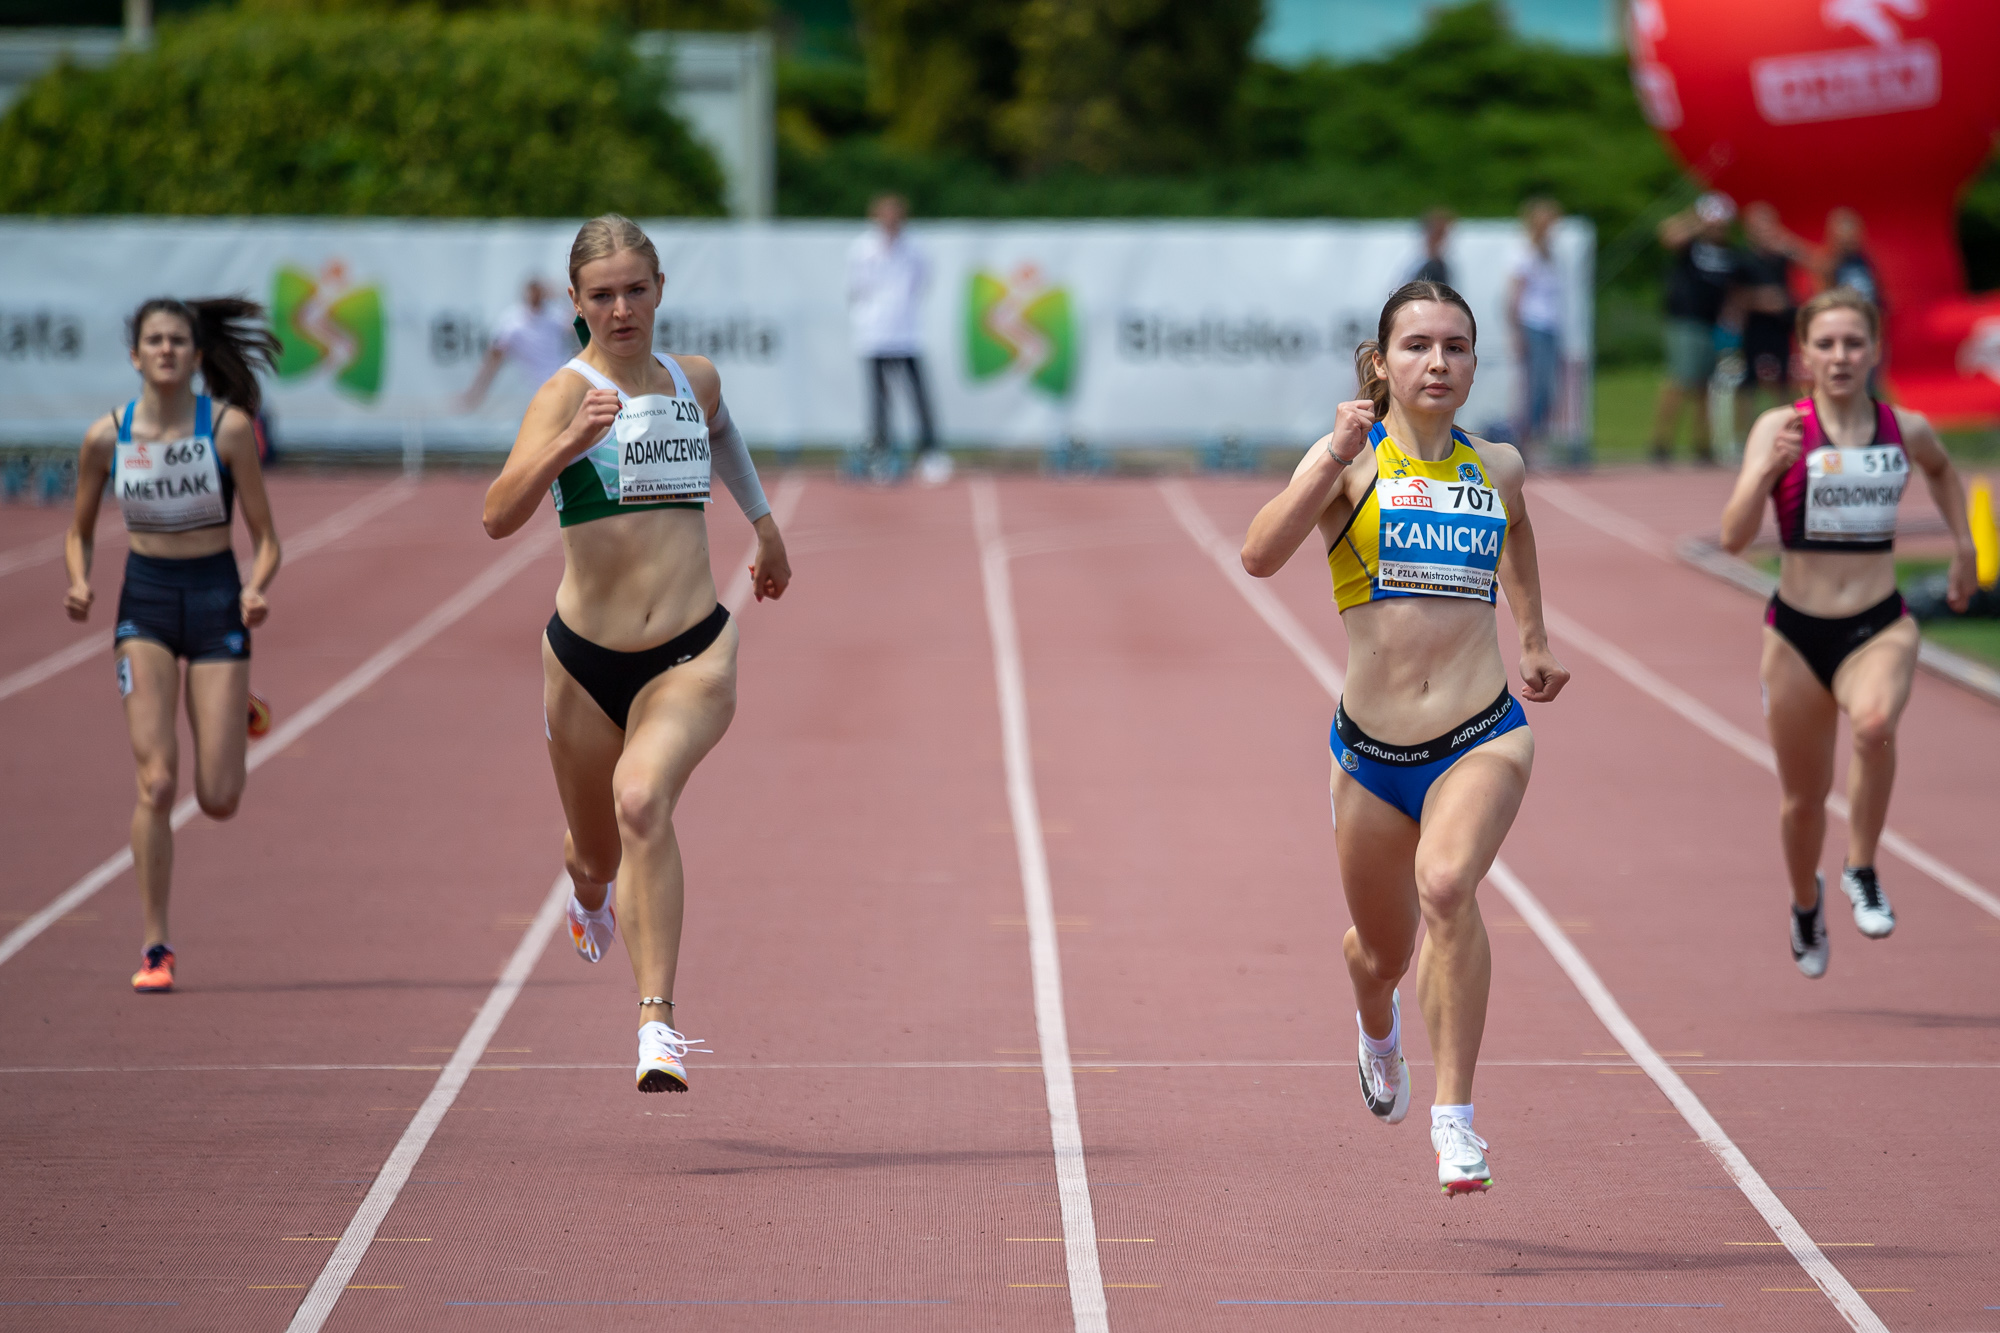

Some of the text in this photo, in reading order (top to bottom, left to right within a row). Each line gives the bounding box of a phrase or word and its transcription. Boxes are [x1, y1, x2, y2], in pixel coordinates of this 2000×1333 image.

[626, 409, 667, 420] MAŁOPOLSKA
[672, 400, 700, 424] 210
[164, 442, 205, 466] 669
[1863, 451, 1903, 473] 516
[124, 472, 211, 500] METLAK
[636, 483, 654, 492] PZLA
[1393, 495, 1432, 507] ORLEN
[1448, 486, 1494, 512] 707
[1385, 522, 1498, 557] KANICKA
[1382, 568, 1395, 577] 54.
[1397, 570, 1419, 578] PZLA
[1421, 571, 1466, 582] Mistrzostwa
[1384, 580, 1443, 591] BIELSKO-BIAŁA
[1451, 698, 1512, 748] AdRunaLine
[1353, 740, 1430, 762] AdRunaLine
